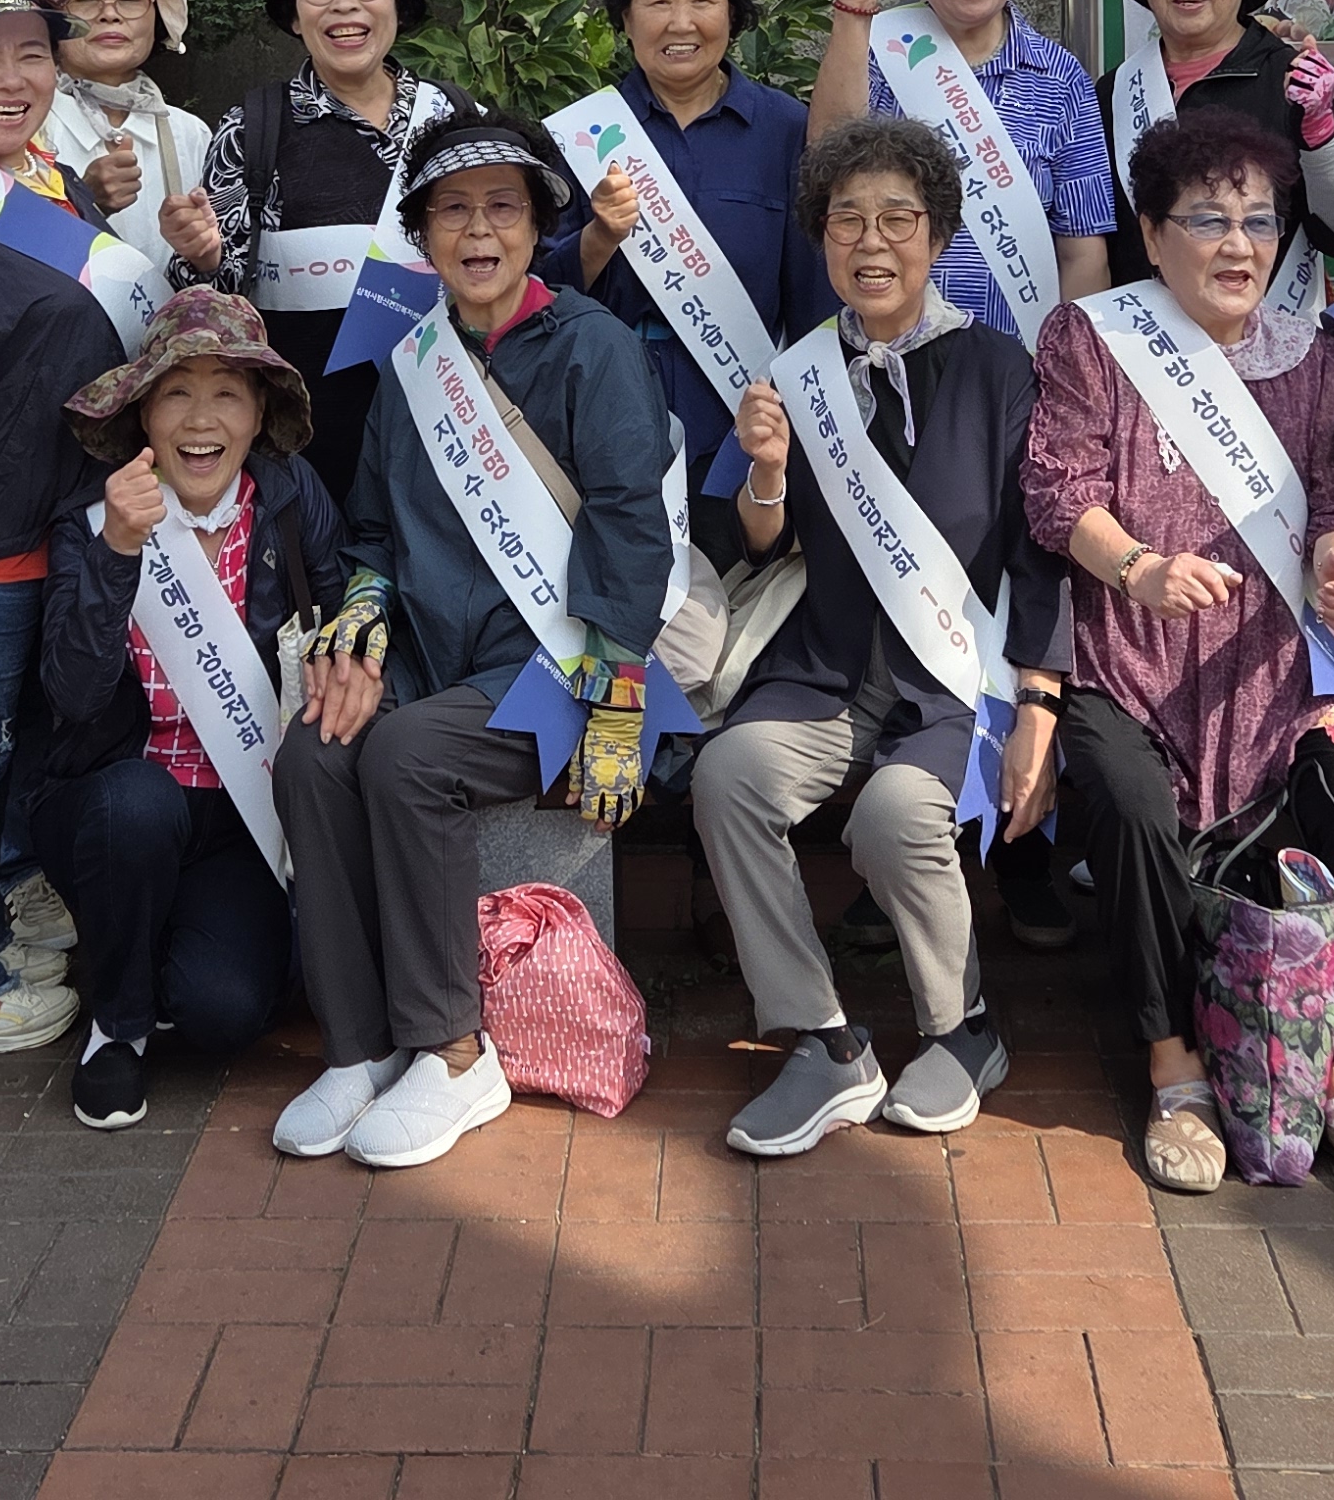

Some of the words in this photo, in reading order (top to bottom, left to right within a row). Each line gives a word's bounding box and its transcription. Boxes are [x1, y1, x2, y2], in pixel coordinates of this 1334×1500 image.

[934, 65, 983, 134] 소중한
[975, 134, 1014, 190] 생명
[1128, 68, 1152, 131] 자살예
[288, 258, 355, 277] 109
[624, 154, 675, 225] 소중한
[668, 225, 712, 278] 생명
[966, 177, 988, 201] 수
[980, 203, 1040, 304] 있습니다
[627, 210, 669, 264] 지킬
[663, 269, 686, 292] 수
[681, 294, 753, 390] 있습니다
[435, 353, 478, 426] 소중한
[470, 426, 511, 481] 생명
[1112, 292, 1195, 387] 자살예방
[1191, 389, 1276, 500] 상담전화
[1273, 508, 1305, 570] 10
[433, 414, 470, 468] 지킬
[463, 473, 486, 498] 수
[479, 501, 560, 608] 있습니다
[799, 363, 849, 469] 자살예방
[845, 468, 921, 580] 상담전화
[919, 584, 969, 656] 109
[195, 641, 266, 752] 상담전화
